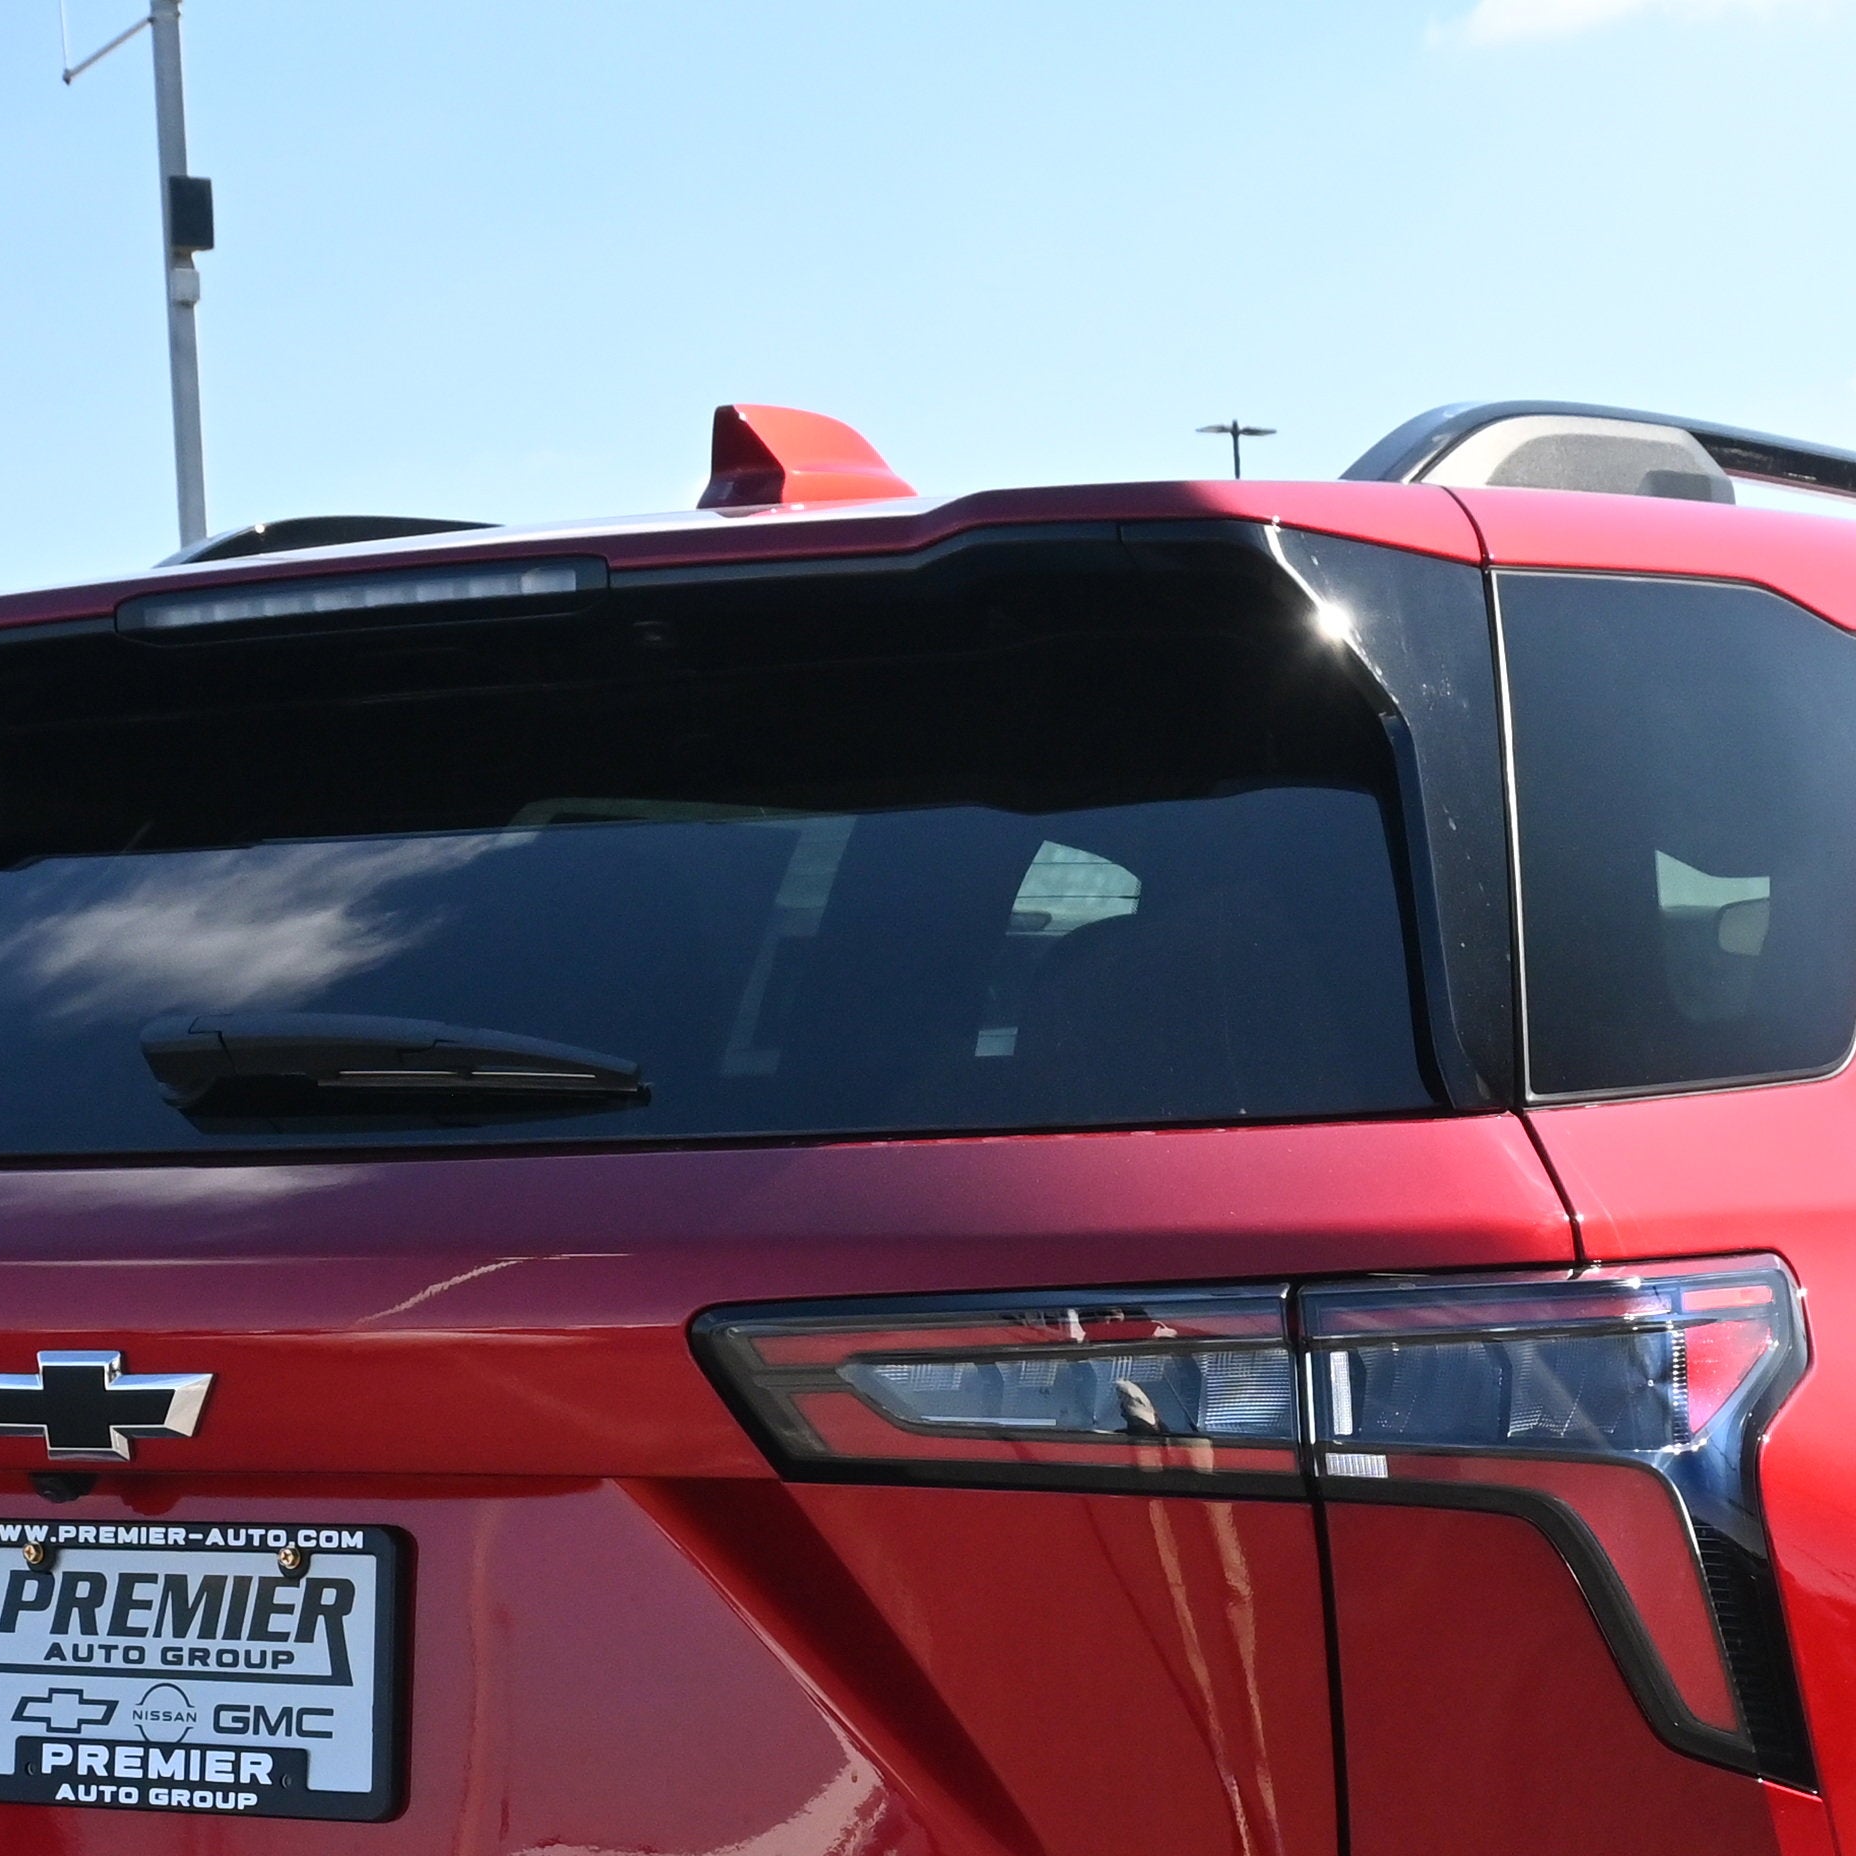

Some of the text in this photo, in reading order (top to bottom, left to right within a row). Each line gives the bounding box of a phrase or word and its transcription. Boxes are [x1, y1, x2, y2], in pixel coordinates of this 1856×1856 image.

[43, 1641, 296, 1670] AUTO GROUP
[132, 1709, 198, 1723] NISSAN
[212, 1703, 334, 1739] GMC
[41, 1742, 274, 1786] PREMIER
[54, 1783, 259, 1811] AUTO GROUP
